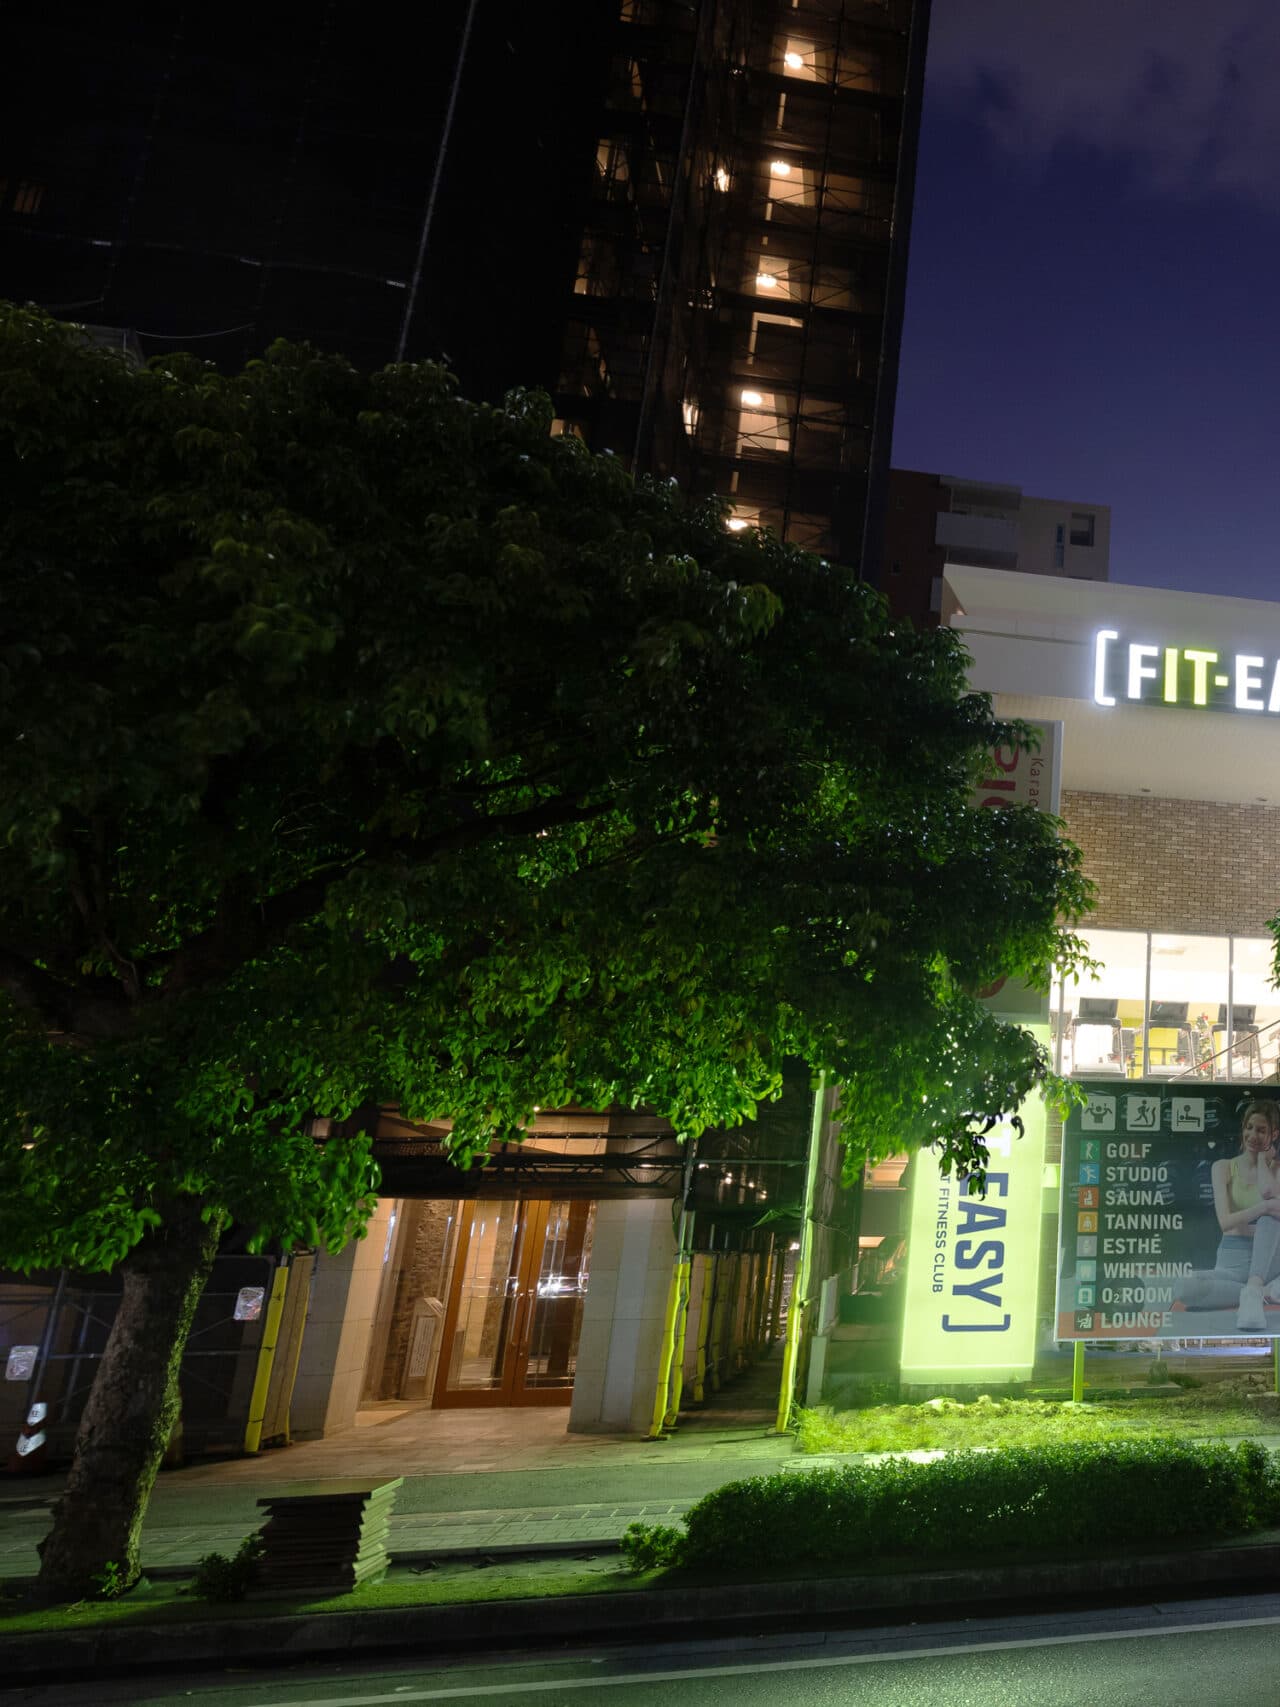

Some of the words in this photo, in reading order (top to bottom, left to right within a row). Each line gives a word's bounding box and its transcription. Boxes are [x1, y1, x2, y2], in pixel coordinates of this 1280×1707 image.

[1029, 757, 1044, 807] Karao
[1106, 1143, 1152, 1158] GOLF
[1105, 1166, 1168, 1182] STUDIO
[1105, 1190, 1164, 1206] SAUNA
[935, 1187, 950, 1249] FITNESS
[1104, 1214, 1183, 1230] TANNING
[1103, 1234, 1162, 1254] ESTHÉ
[932, 1252, 946, 1293] CLUB
[1103, 1262, 1193, 1279] WHITENING
[1101, 1311, 1173, 1329] LOUNGE
